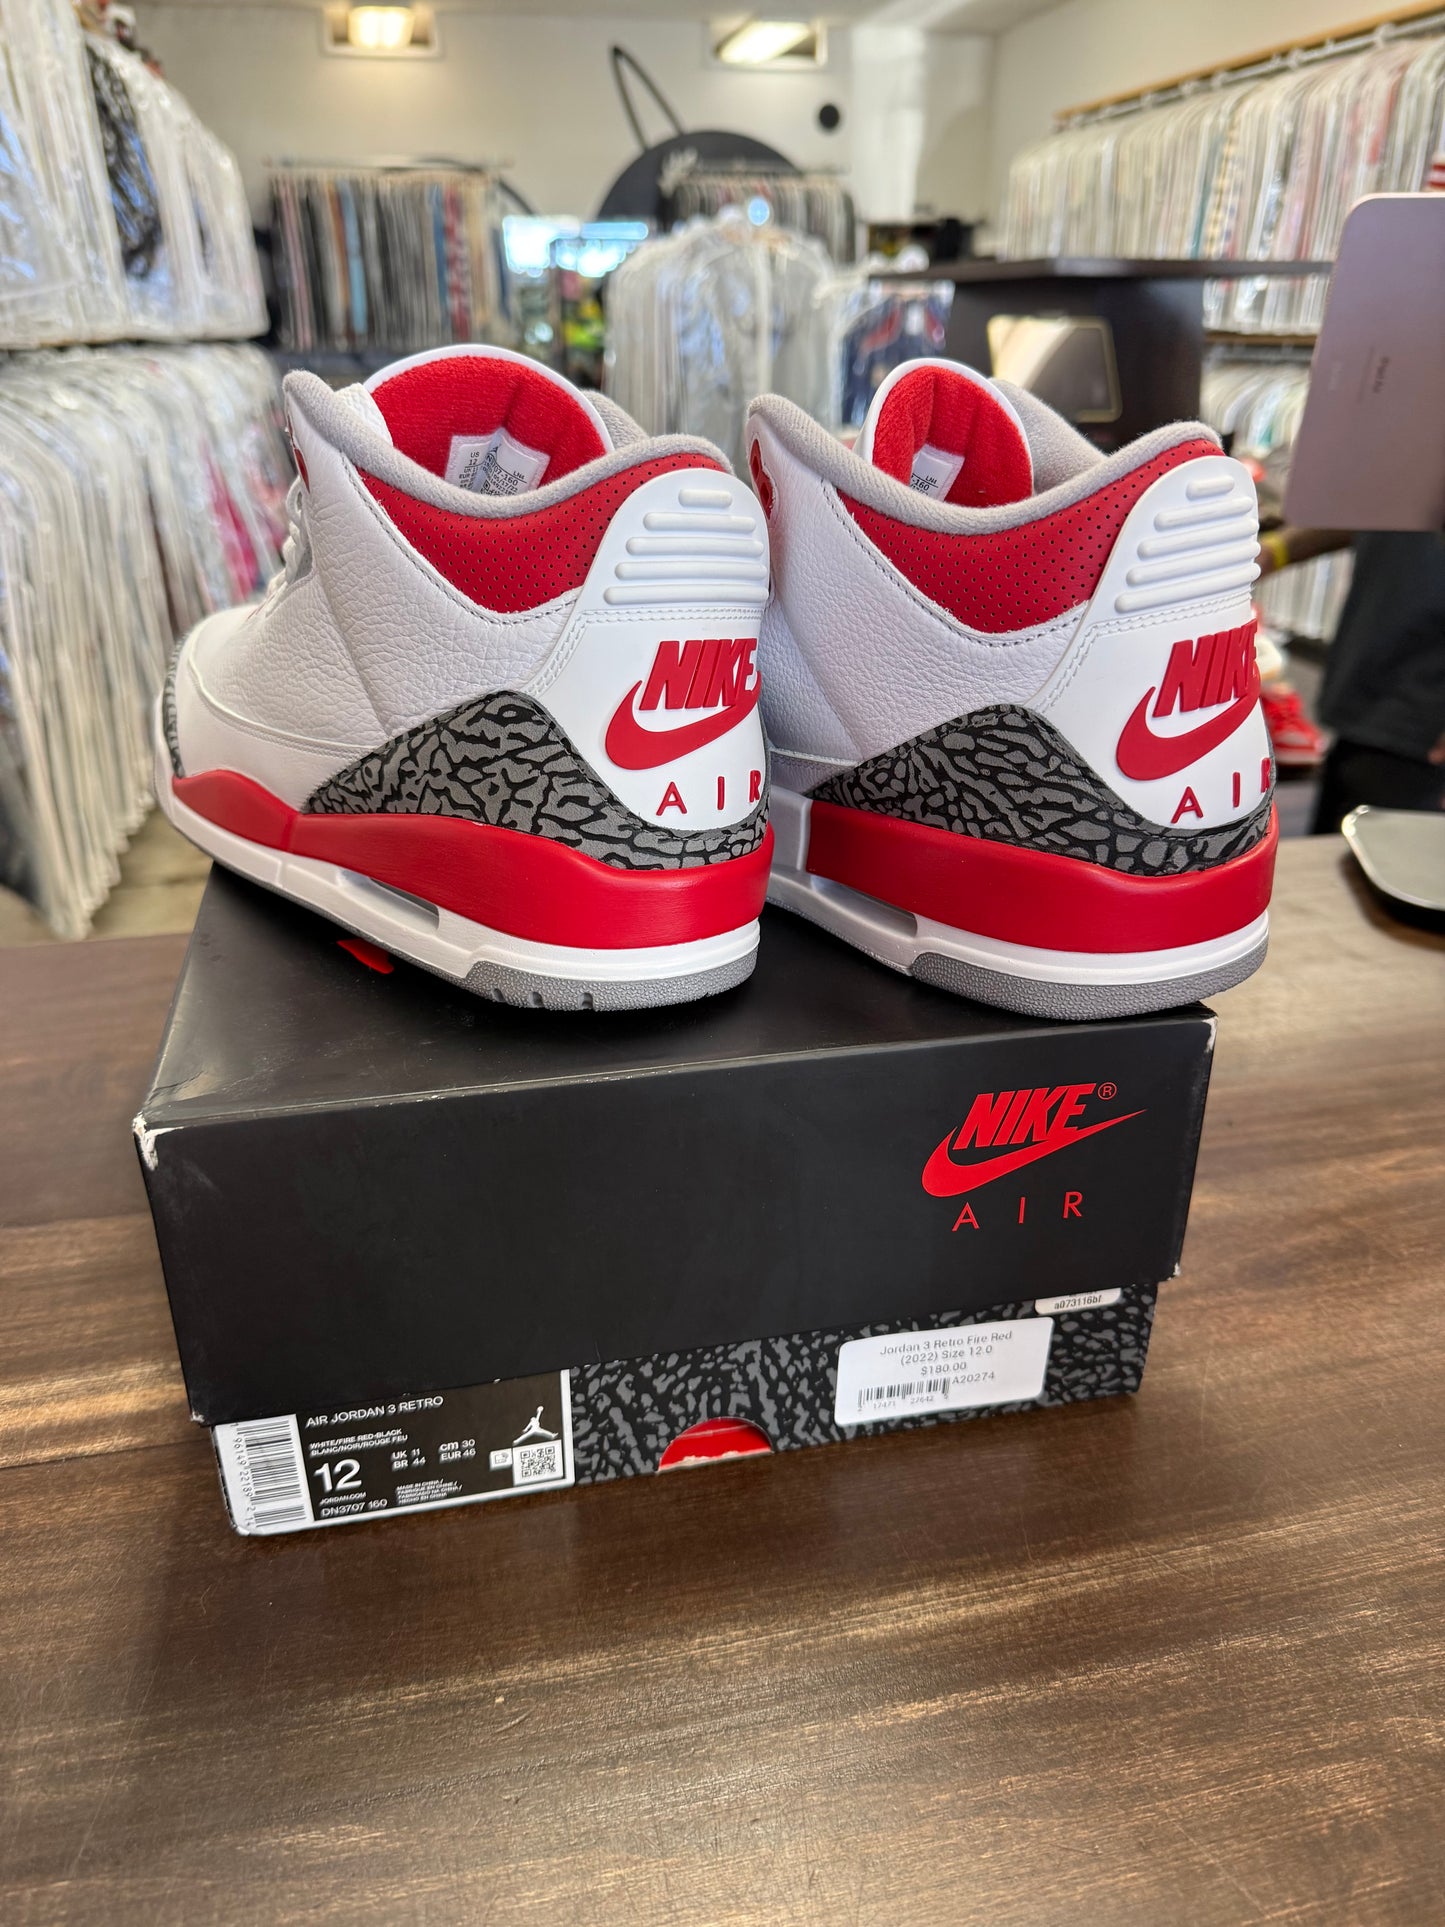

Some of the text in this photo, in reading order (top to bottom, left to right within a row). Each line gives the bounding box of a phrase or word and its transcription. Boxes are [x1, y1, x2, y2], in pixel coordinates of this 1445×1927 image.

[639, 638, 758, 710] NIKE
[1152, 618, 1257, 718] NIKE
[656, 770, 762, 816] AIR
[952, 1191, 1083, 1231] AIR
[880, 1331, 1013, 1356] Jordan 3 Retro Fire Red
[900, 1345, 993, 1366] (2022) Size 12.0
[920, 1362, 967, 1376] $180.00
[952, 1371, 995, 1385] A20274
[305, 1396, 444, 1428] AIR JORDAN 3 RETRO
[309, 1436, 357, 1449] WHITE/FIRE
[440, 1438, 476, 1453] cm 30
[391, 1448, 421, 1461] UK 11
[392, 1456, 426, 1471] BR 44
[440, 1448, 476, 1463] EUR 46
[314, 1458, 362, 1493] 12
[321, 1498, 388, 1516] DN3707 160
